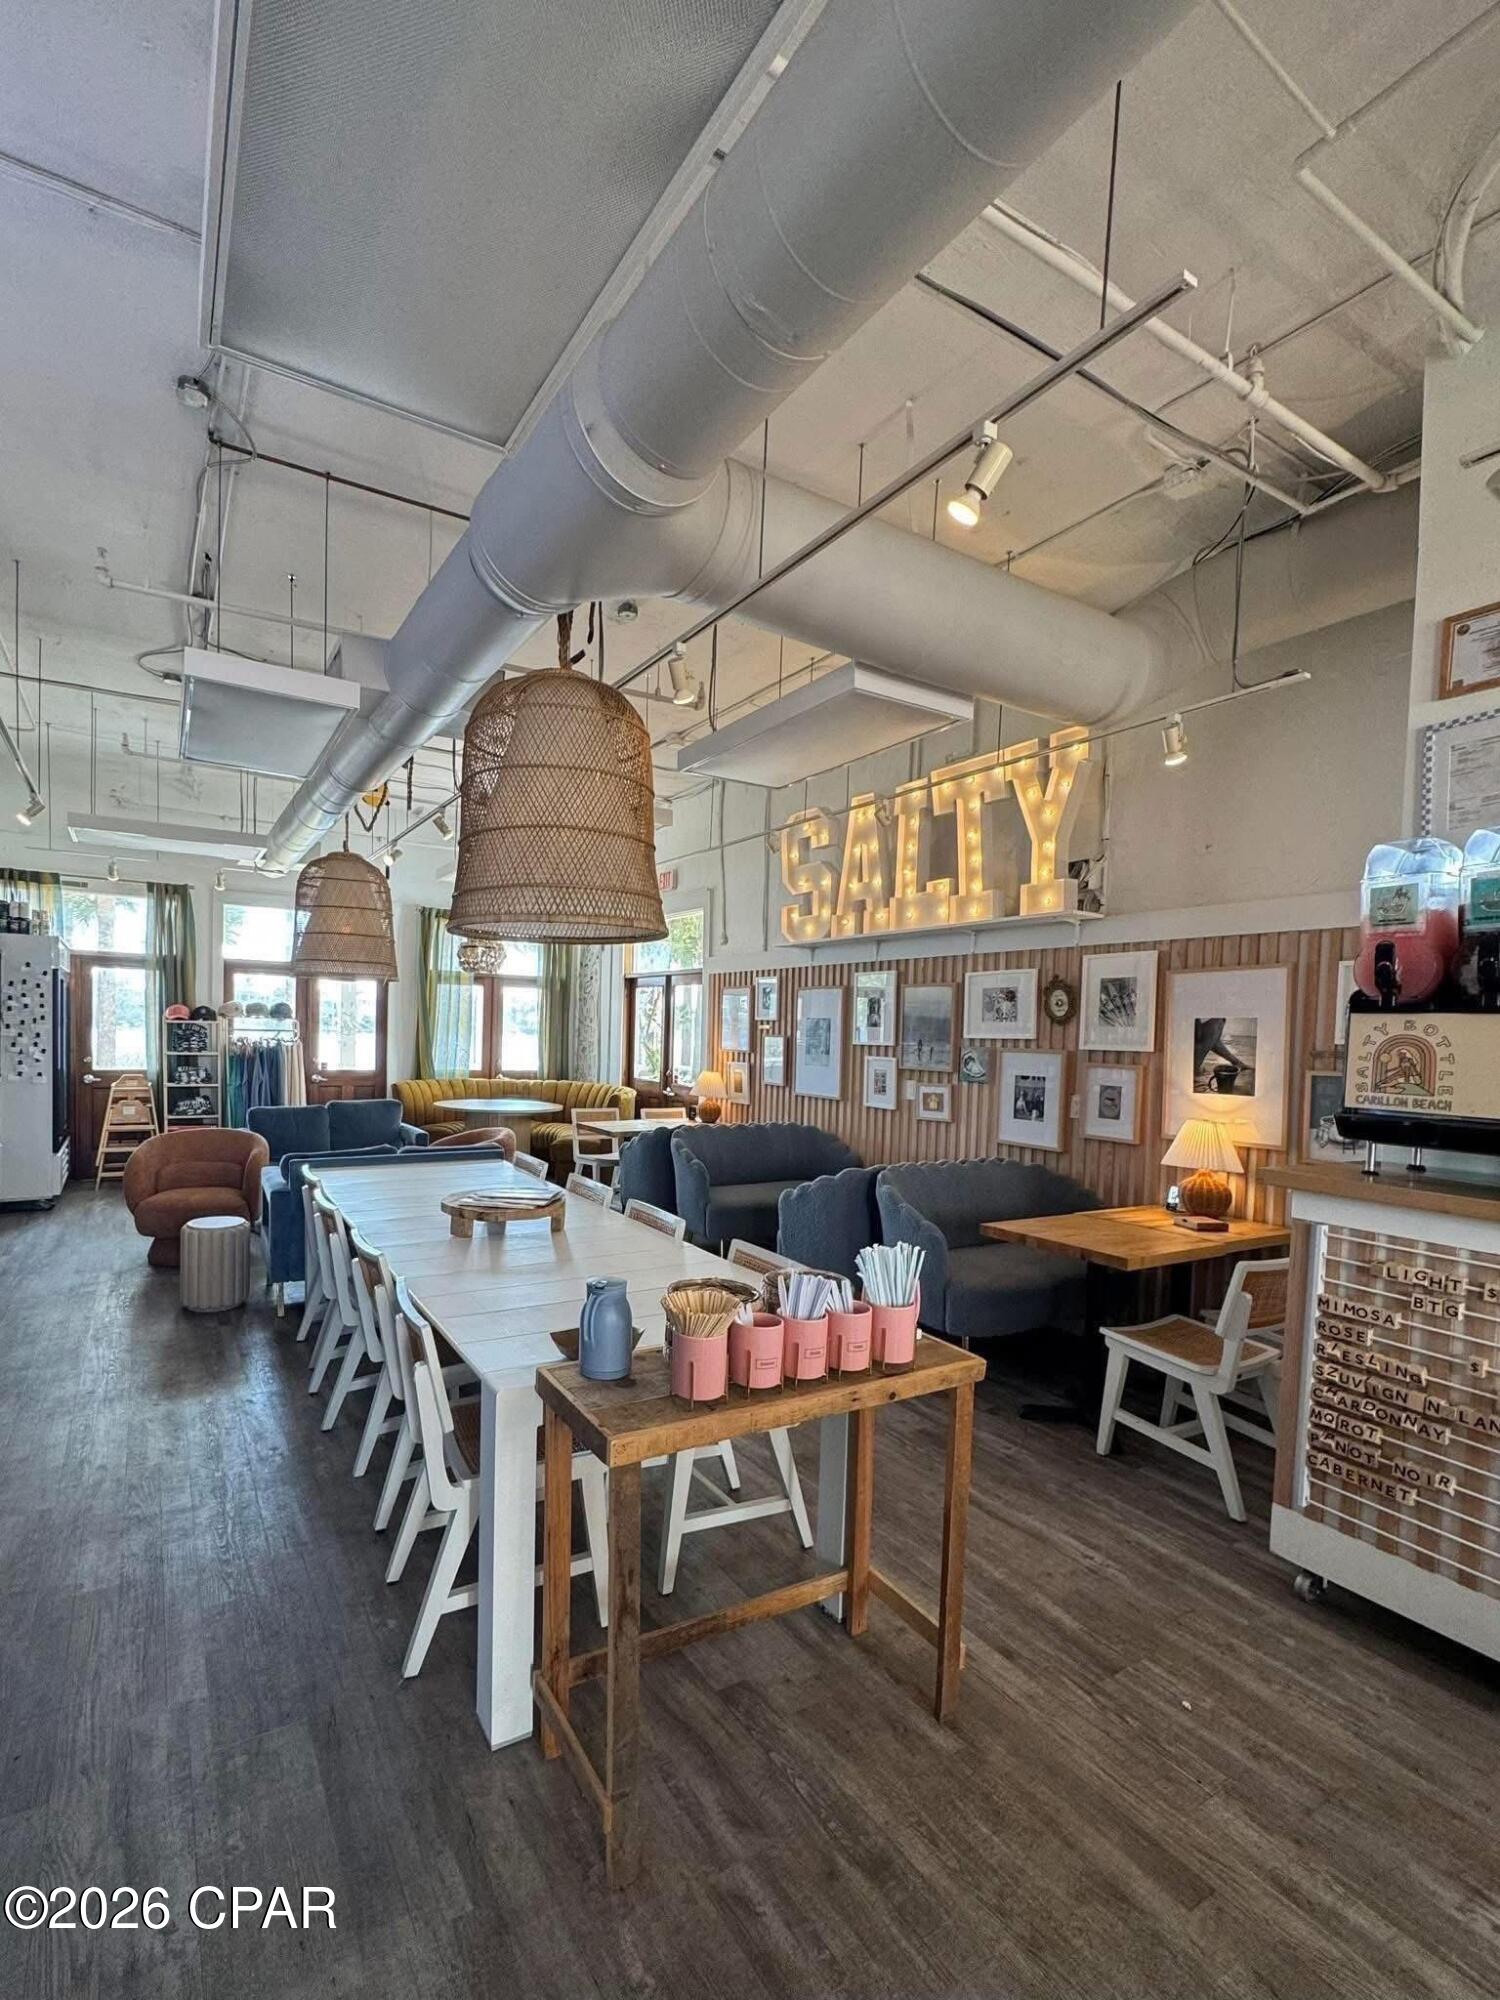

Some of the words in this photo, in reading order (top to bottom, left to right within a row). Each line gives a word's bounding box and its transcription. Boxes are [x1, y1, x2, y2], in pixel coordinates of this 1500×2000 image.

[781, 726, 1090, 942] SALTY
[1355, 1022, 1389, 1093] SALTY
[1404, 1020, 1456, 1096] BOTTLE
[1412, 1098, 1452, 1112] BEACH
[1387, 1266, 1462, 1292] LIGHT
[1317, 1297, 1395, 1327] MIMOSA
[1414, 1297, 1458, 1318] BTG
[1317, 1321, 1365, 1343] ROSE
[1316, 1343, 1422, 1384] RIESLING
[1313, 1386, 1445, 1440] CHARDONNAY
[1307, 1454, 1410, 1500] CABERNET
[1394, 1463, 1450, 1488] NOIR
